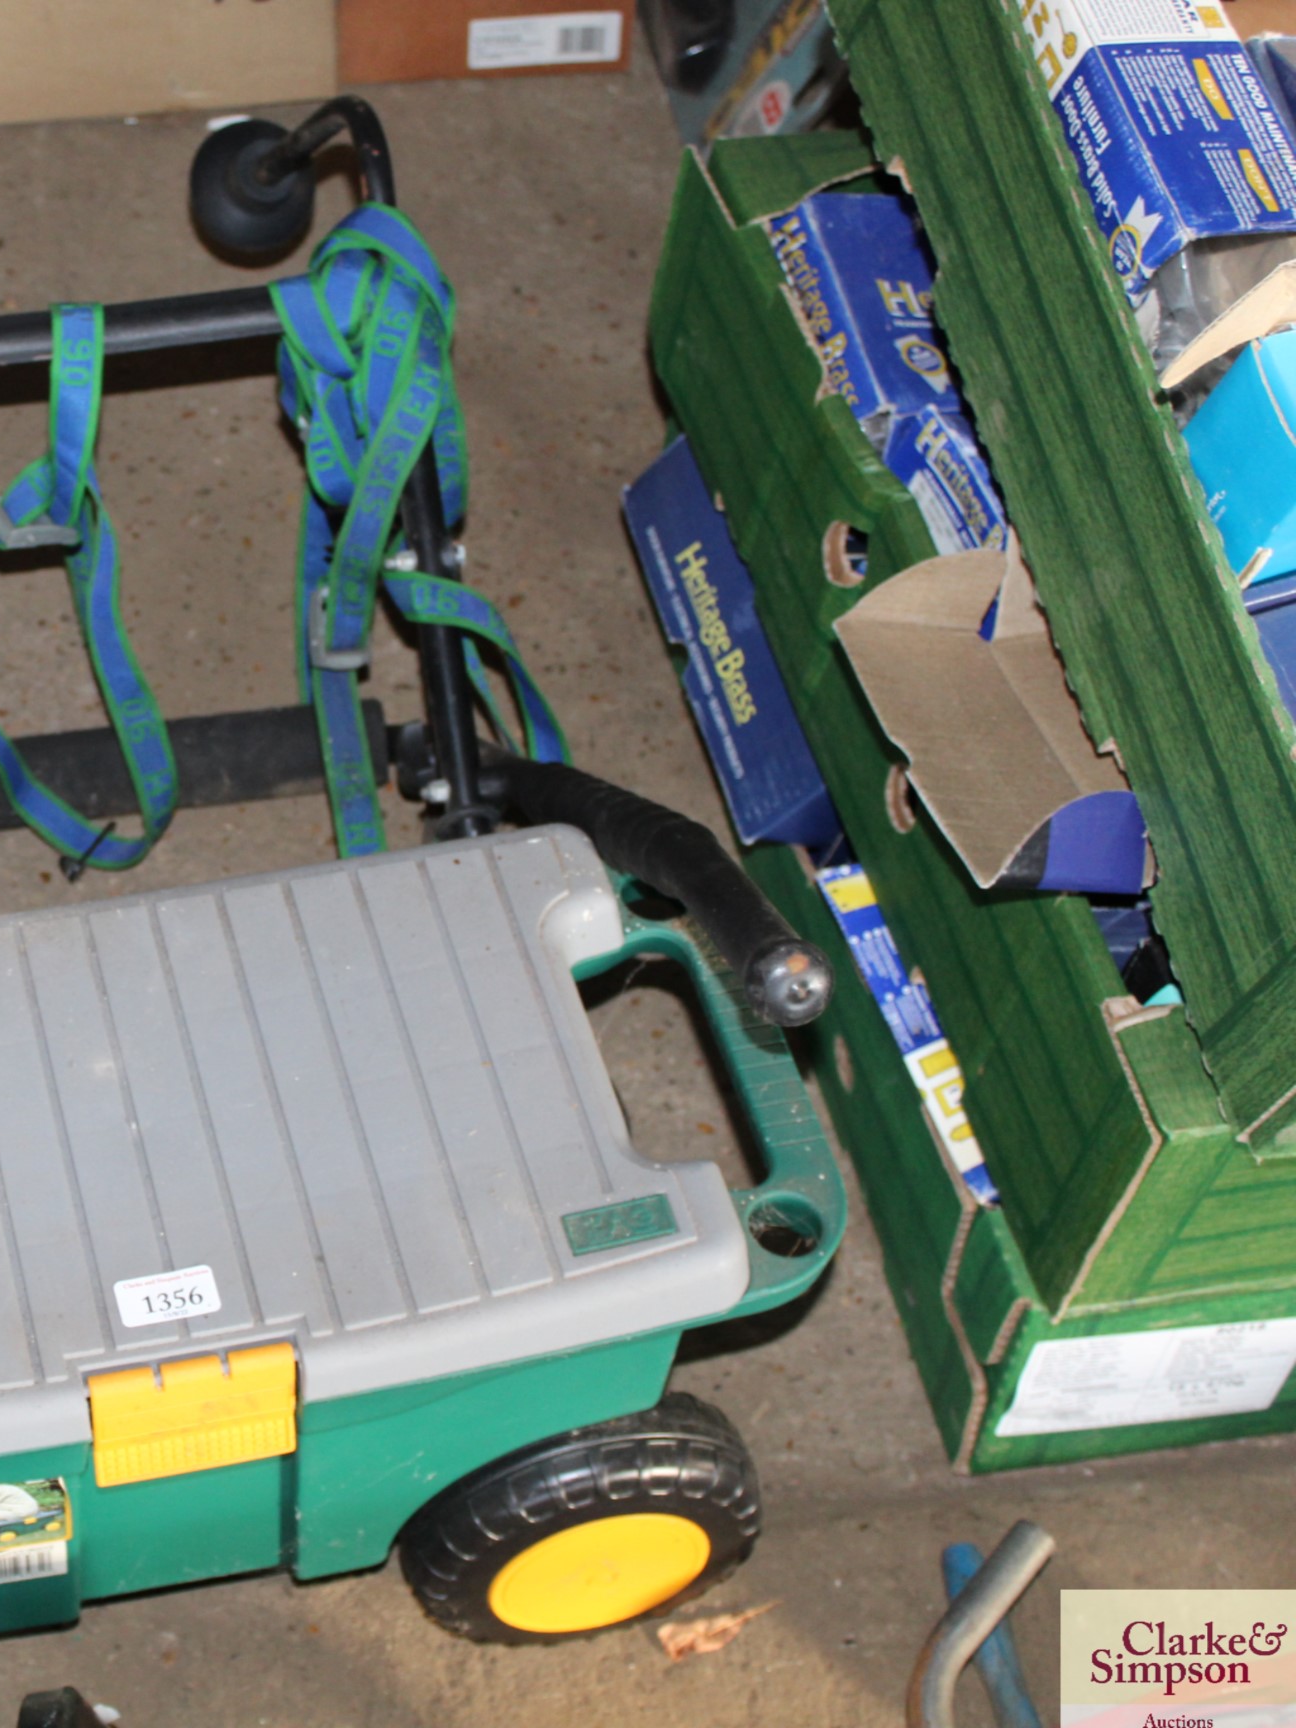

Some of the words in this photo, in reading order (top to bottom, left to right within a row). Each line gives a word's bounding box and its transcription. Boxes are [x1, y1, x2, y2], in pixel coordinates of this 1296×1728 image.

[1201, 78, 1220, 100] DO
[1229, 54, 1251, 73] TEN
[1240, 75, 1269, 108] GOOD
[1058, 92, 1084, 138] Door
[1070, 73, 1113, 155] Furniture
[1074, 131, 1100, 175] Brass
[1090, 170, 1117, 218] Solid
[1243, 157, 1271, 199] DON'T
[370, 305, 414, 360] 06
[770, 215, 833, 340] Heritage
[818, 331, 859, 409] Brass
[61, 338, 93, 386] 06
[358, 361, 444, 518] SYSTEM
[915, 419, 990, 540] Heritage
[412, 580, 459, 616] 06
[675, 541, 732, 659] Heritage
[714, 642, 759, 726] Brass
[141, 1286, 204, 1314] 1356
